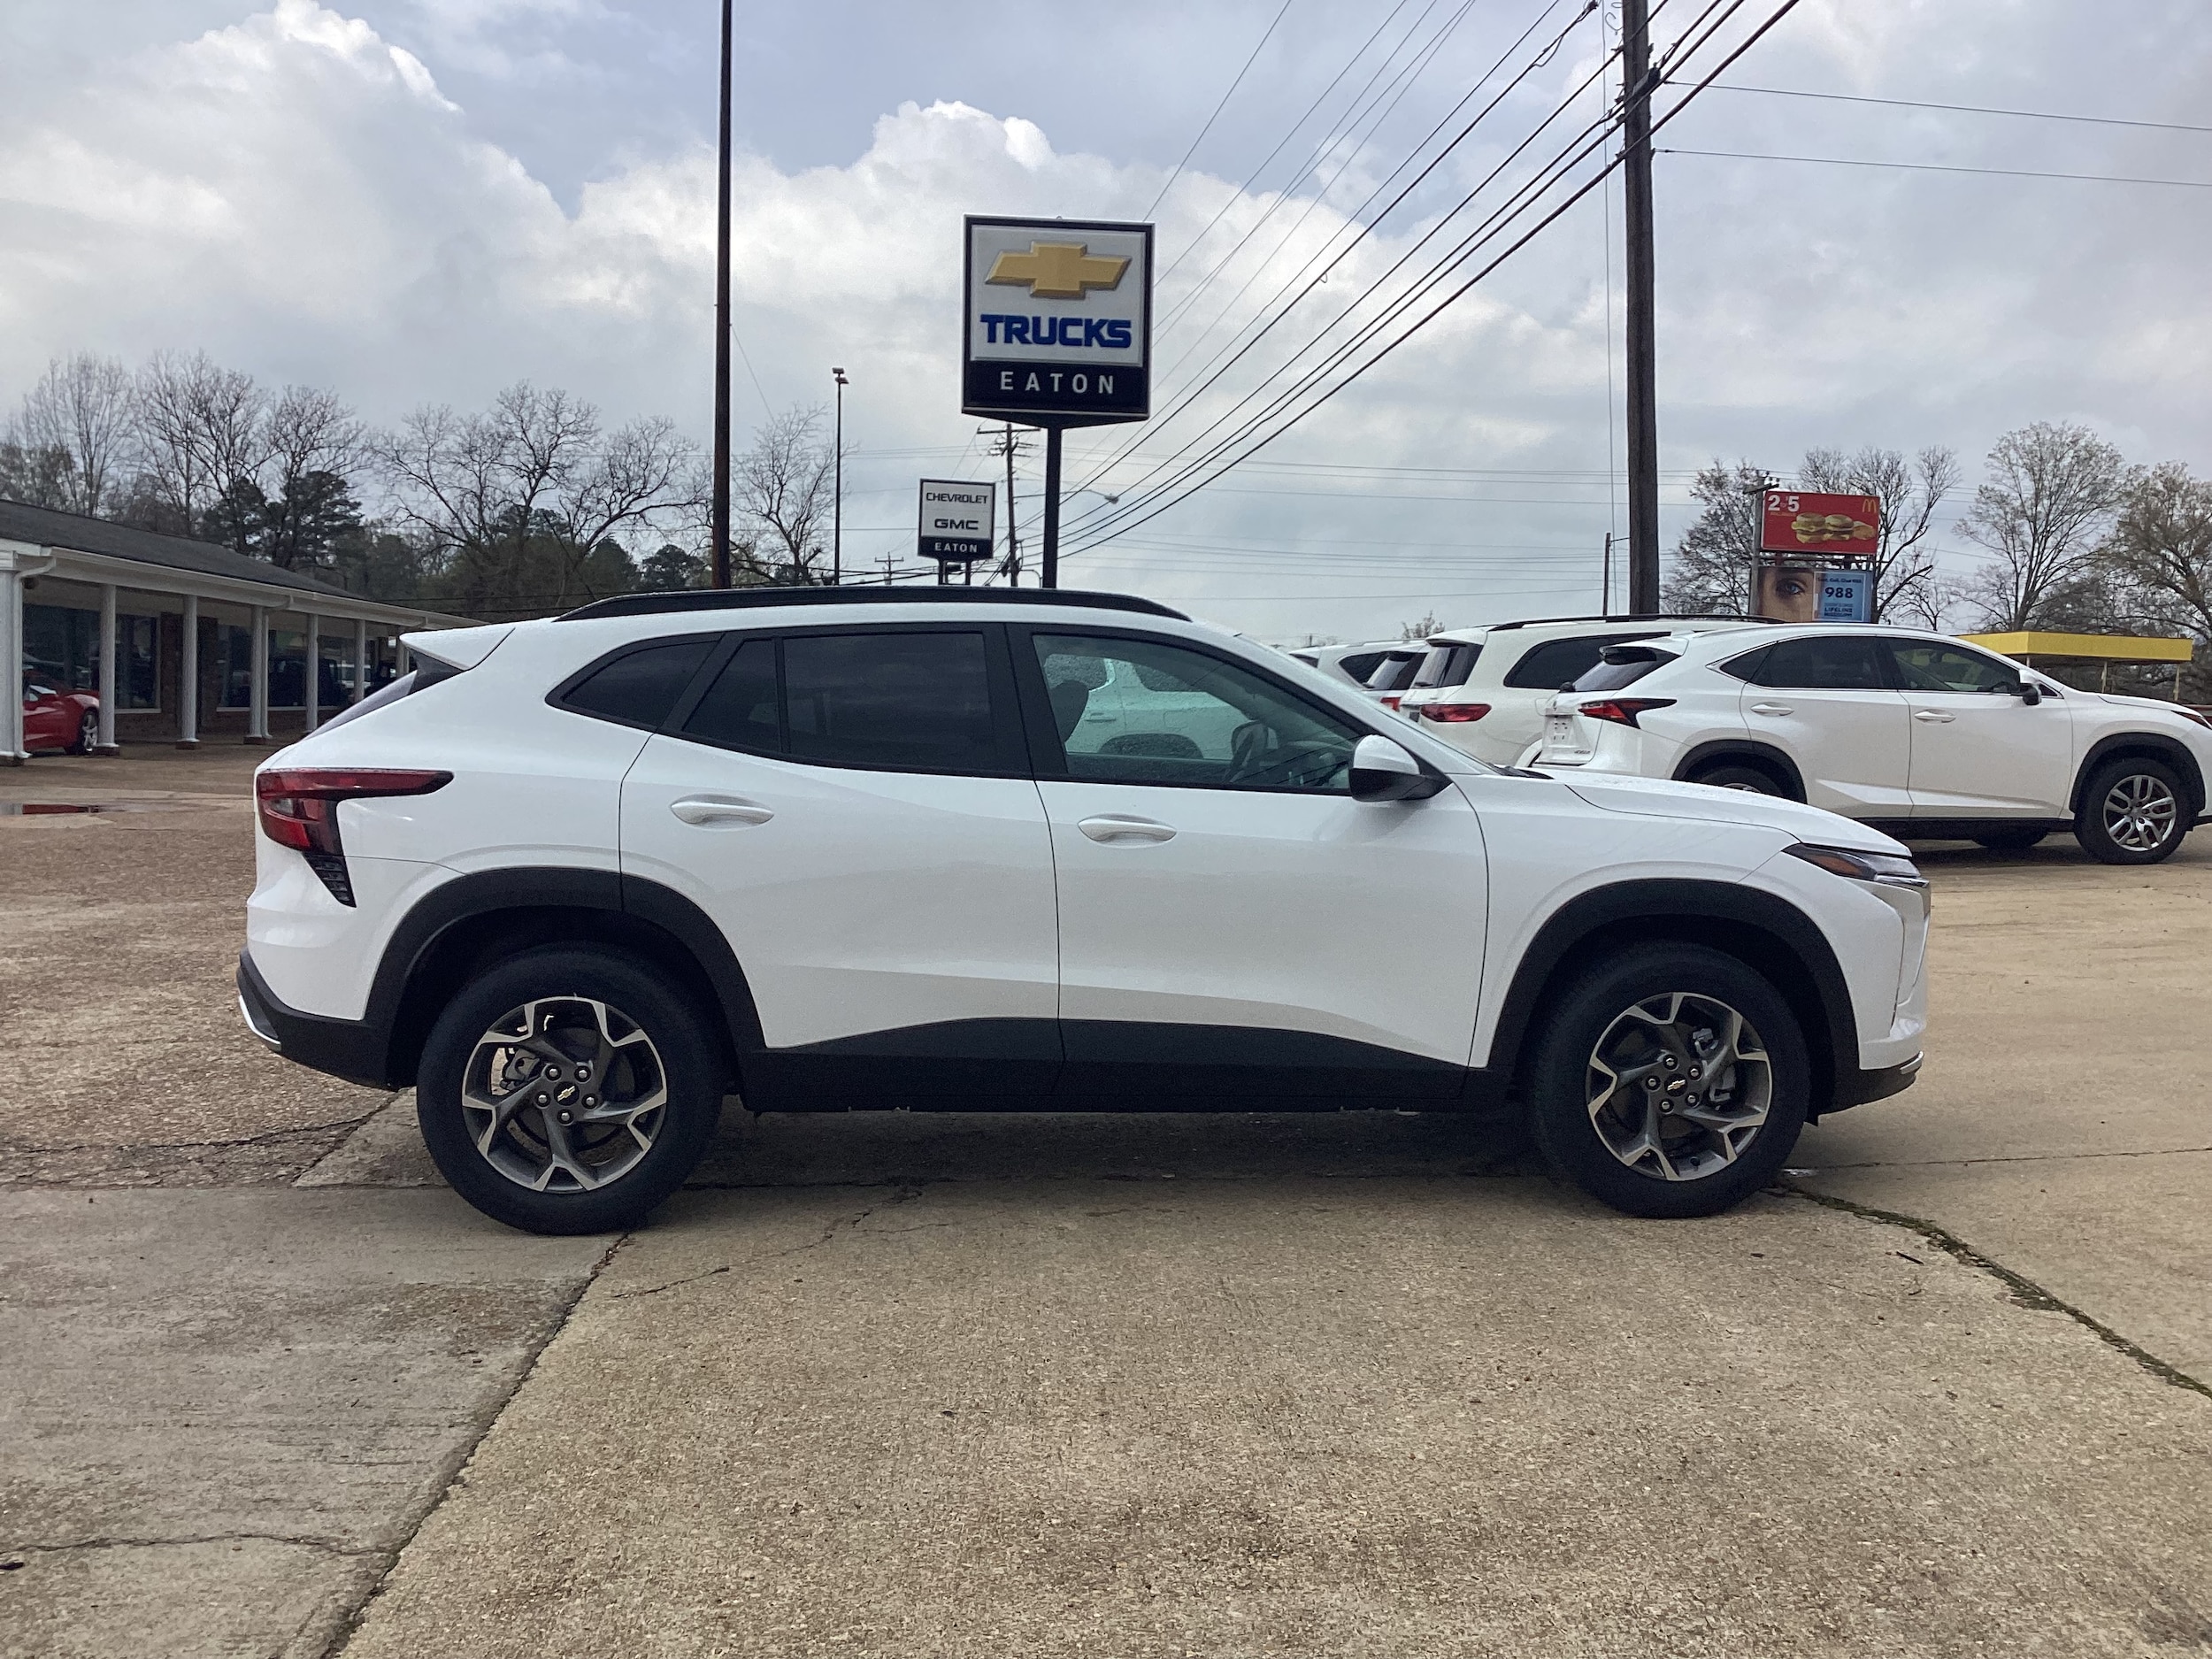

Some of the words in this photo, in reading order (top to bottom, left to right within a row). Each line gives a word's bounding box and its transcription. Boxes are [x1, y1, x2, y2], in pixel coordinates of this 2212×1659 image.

[980, 313, 1132, 349] TRUCKS
[1000, 371, 1114, 395] EATON
[926, 492, 988, 504] CHEVROLET
[1768, 495, 1780, 511] 2
[934, 518, 979, 530] GMC
[934, 542, 978, 553] EATON
[1824, 587, 1854, 598] 988
